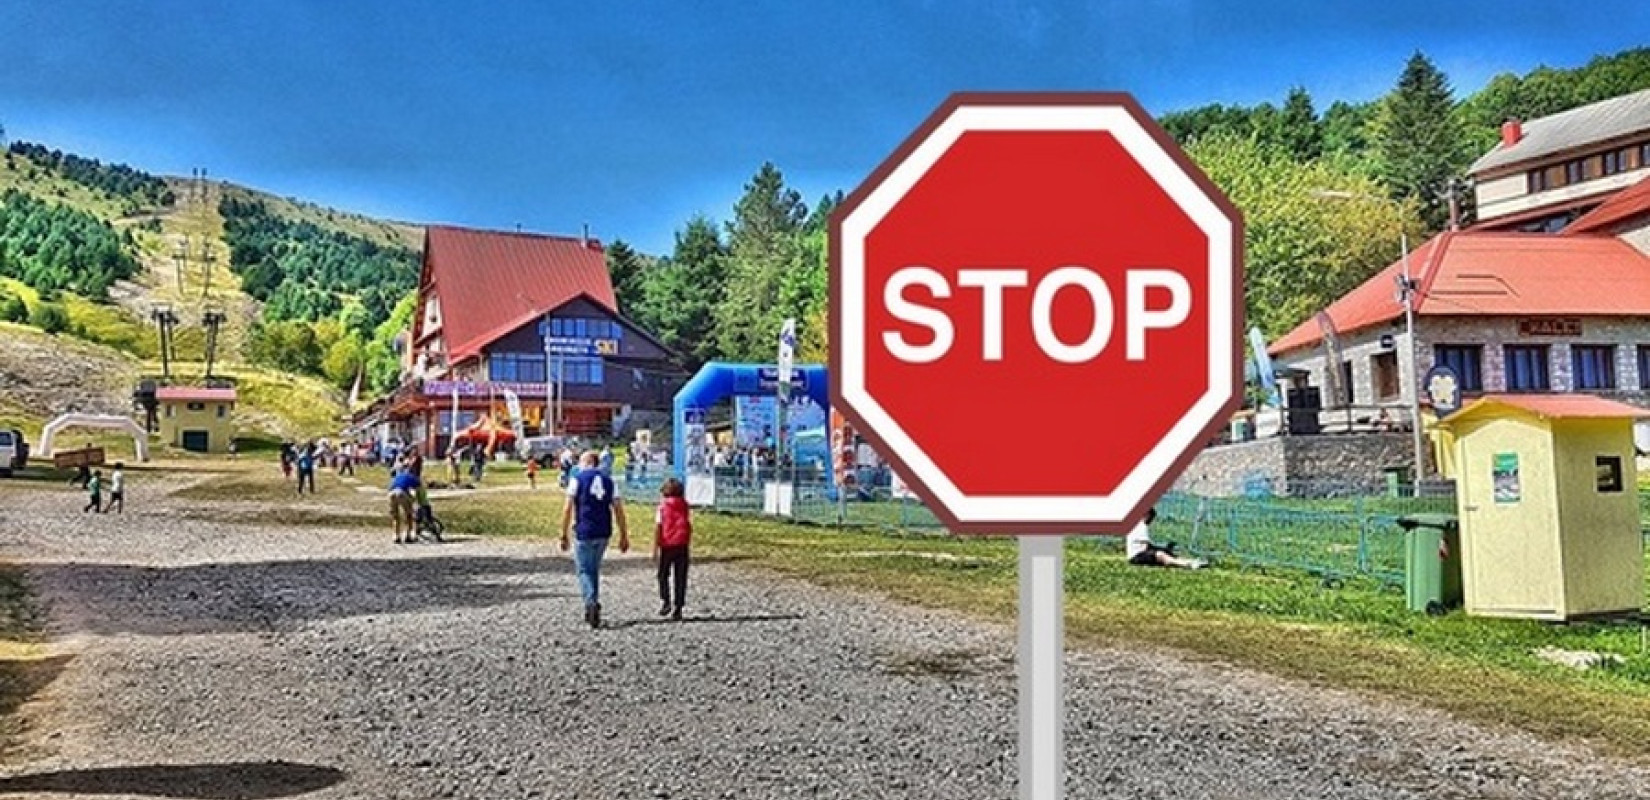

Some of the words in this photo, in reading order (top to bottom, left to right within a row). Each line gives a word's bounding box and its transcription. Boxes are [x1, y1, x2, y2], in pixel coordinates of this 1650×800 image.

[882, 266, 1192, 363] STOP
[594, 339, 619, 355] SKI
[590, 475, 605, 500] 4
